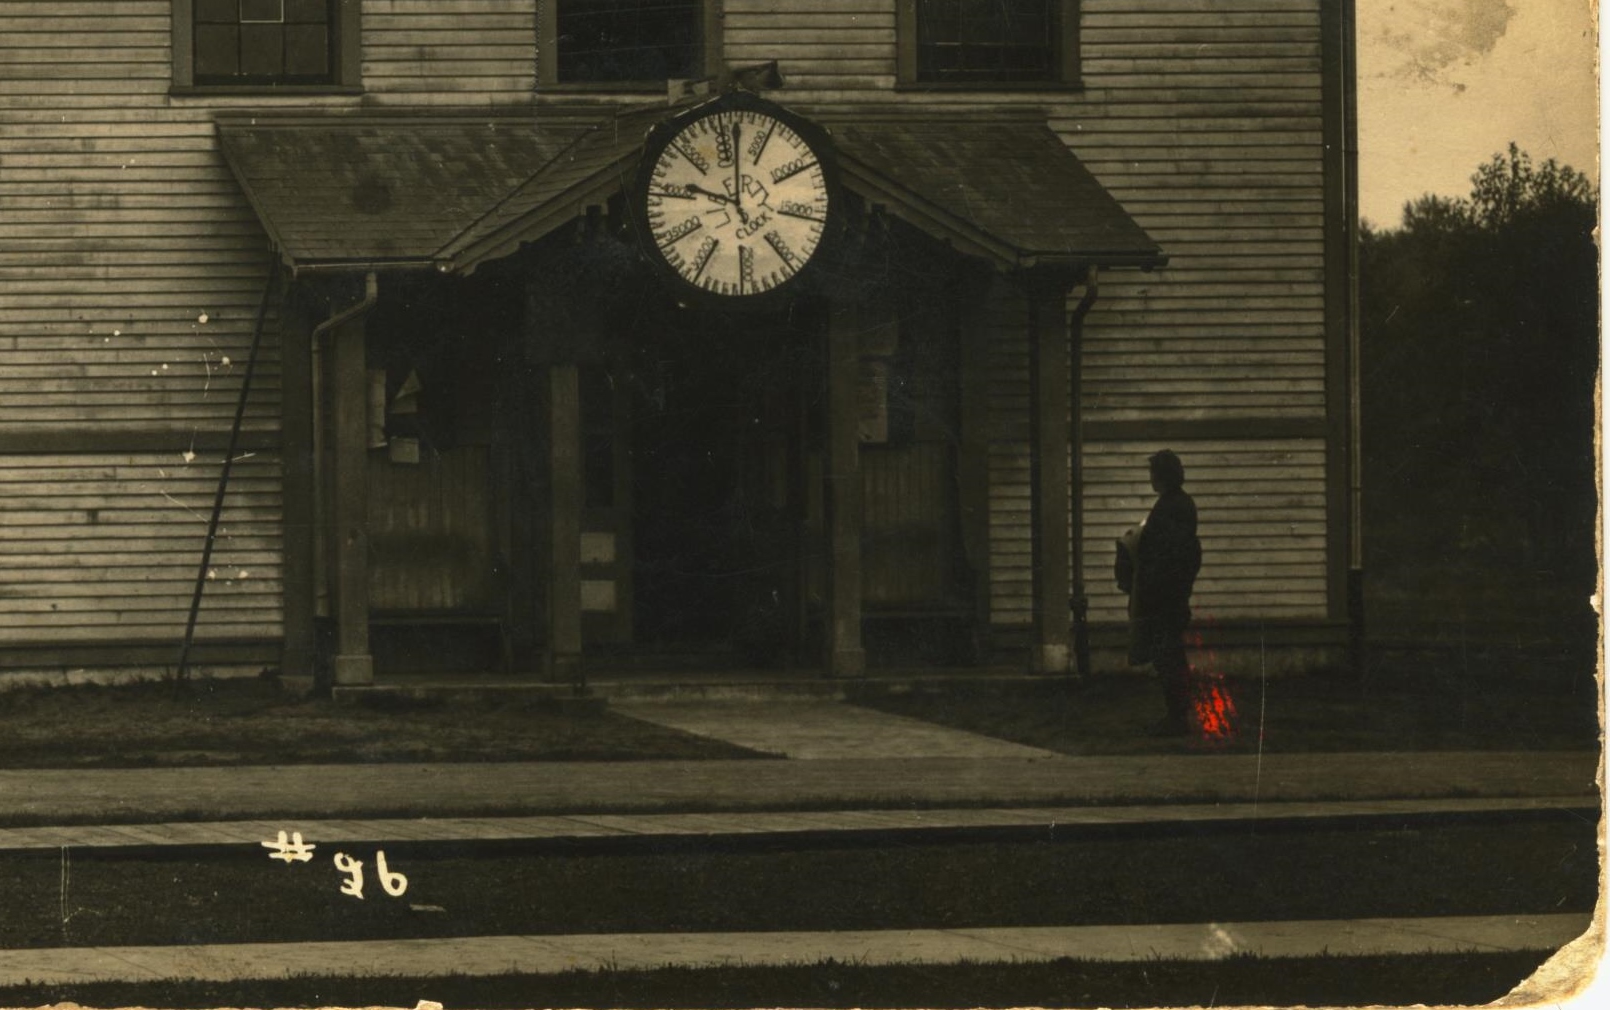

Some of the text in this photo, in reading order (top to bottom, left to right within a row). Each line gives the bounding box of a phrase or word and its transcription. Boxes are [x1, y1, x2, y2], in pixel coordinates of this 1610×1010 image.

[747, 130, 766, 157] 5000
[770, 158, 804, 184] 10000
[780, 199, 813, 216] 15000
[664, 215, 700, 242] 35000
[735, 211, 773, 239] CLOCK
[690, 235, 715, 271] 30000
